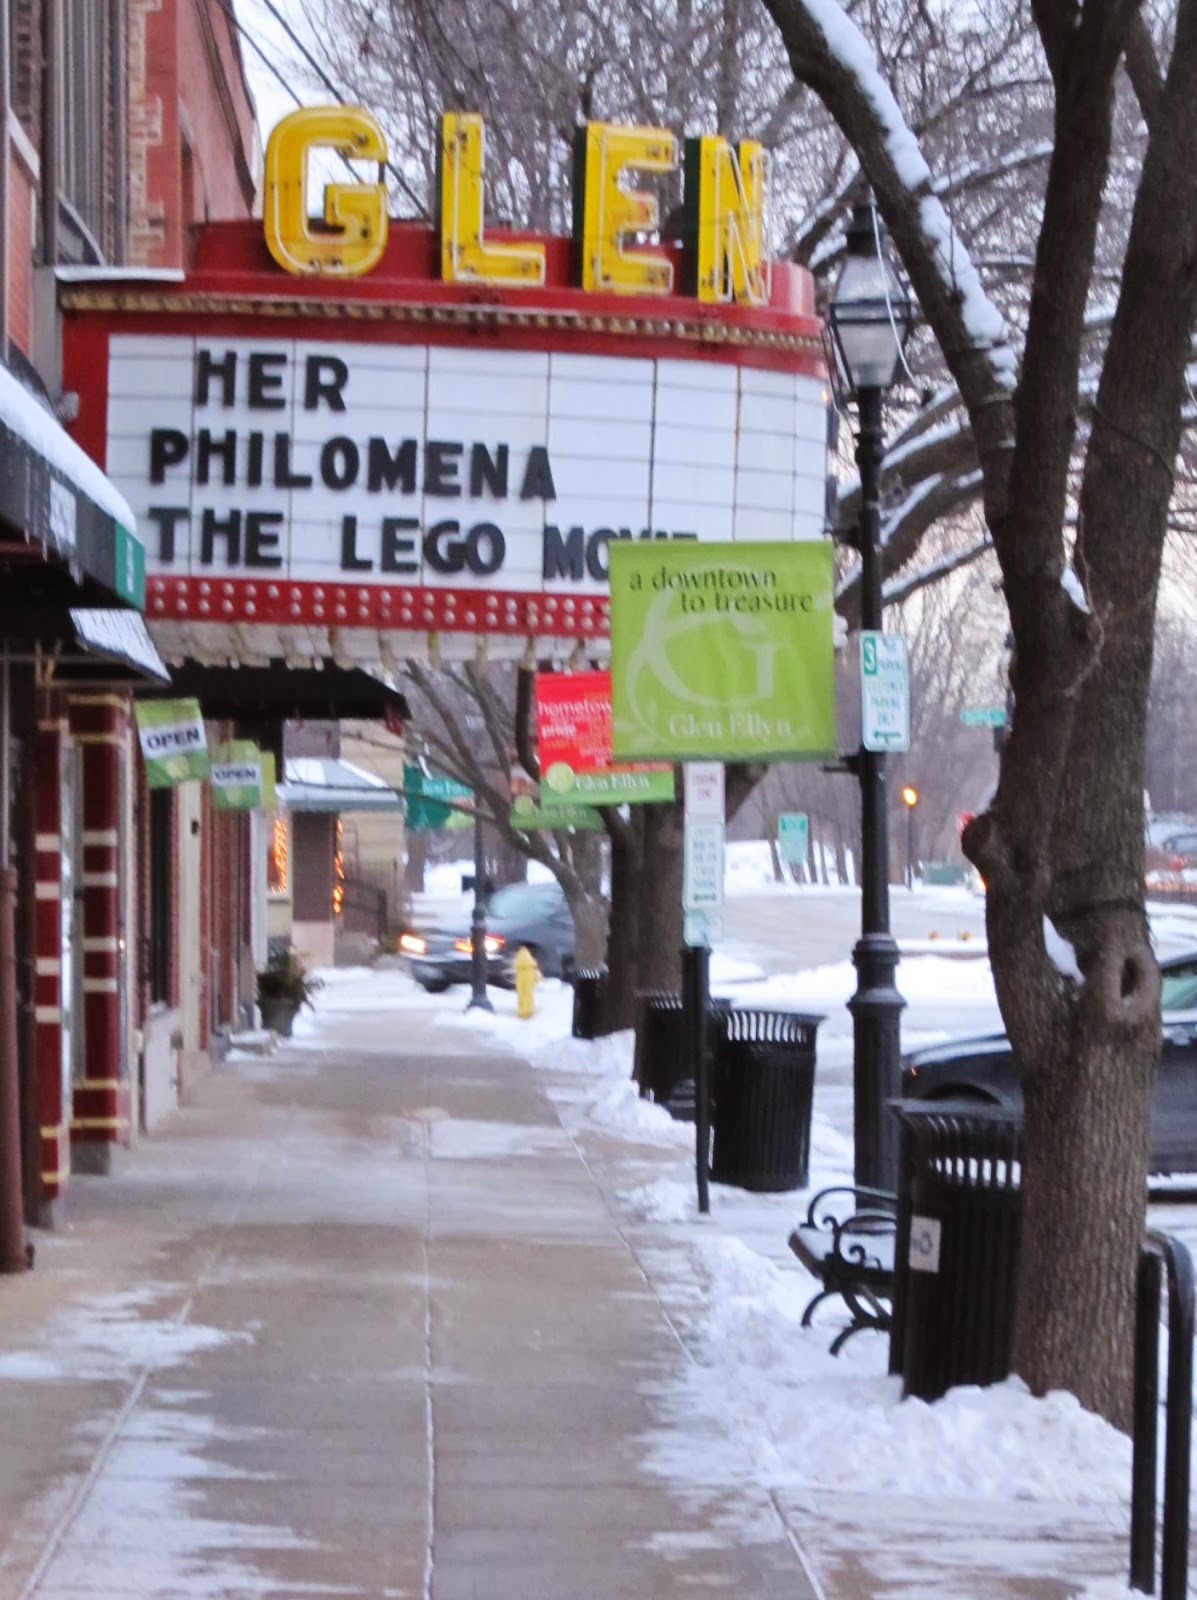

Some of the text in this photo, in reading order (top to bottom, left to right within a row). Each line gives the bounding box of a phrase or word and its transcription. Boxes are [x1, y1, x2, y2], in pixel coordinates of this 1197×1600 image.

[264, 105, 772, 307] GLEN
[197, 349, 349, 412] HER
[149, 427, 556, 500] PHILOMENA
[148, 506, 283, 567] THE
[341, 514, 506, 575] LEGO
[630, 566, 777, 592] a downtown
[681, 591, 814, 614] to treasure
[538, 699, 612, 717] hometow
[147, 726, 200, 750] OPEN
[669, 711, 792, 739] Glen Ellyn
[214, 767, 257, 781] OPEN
